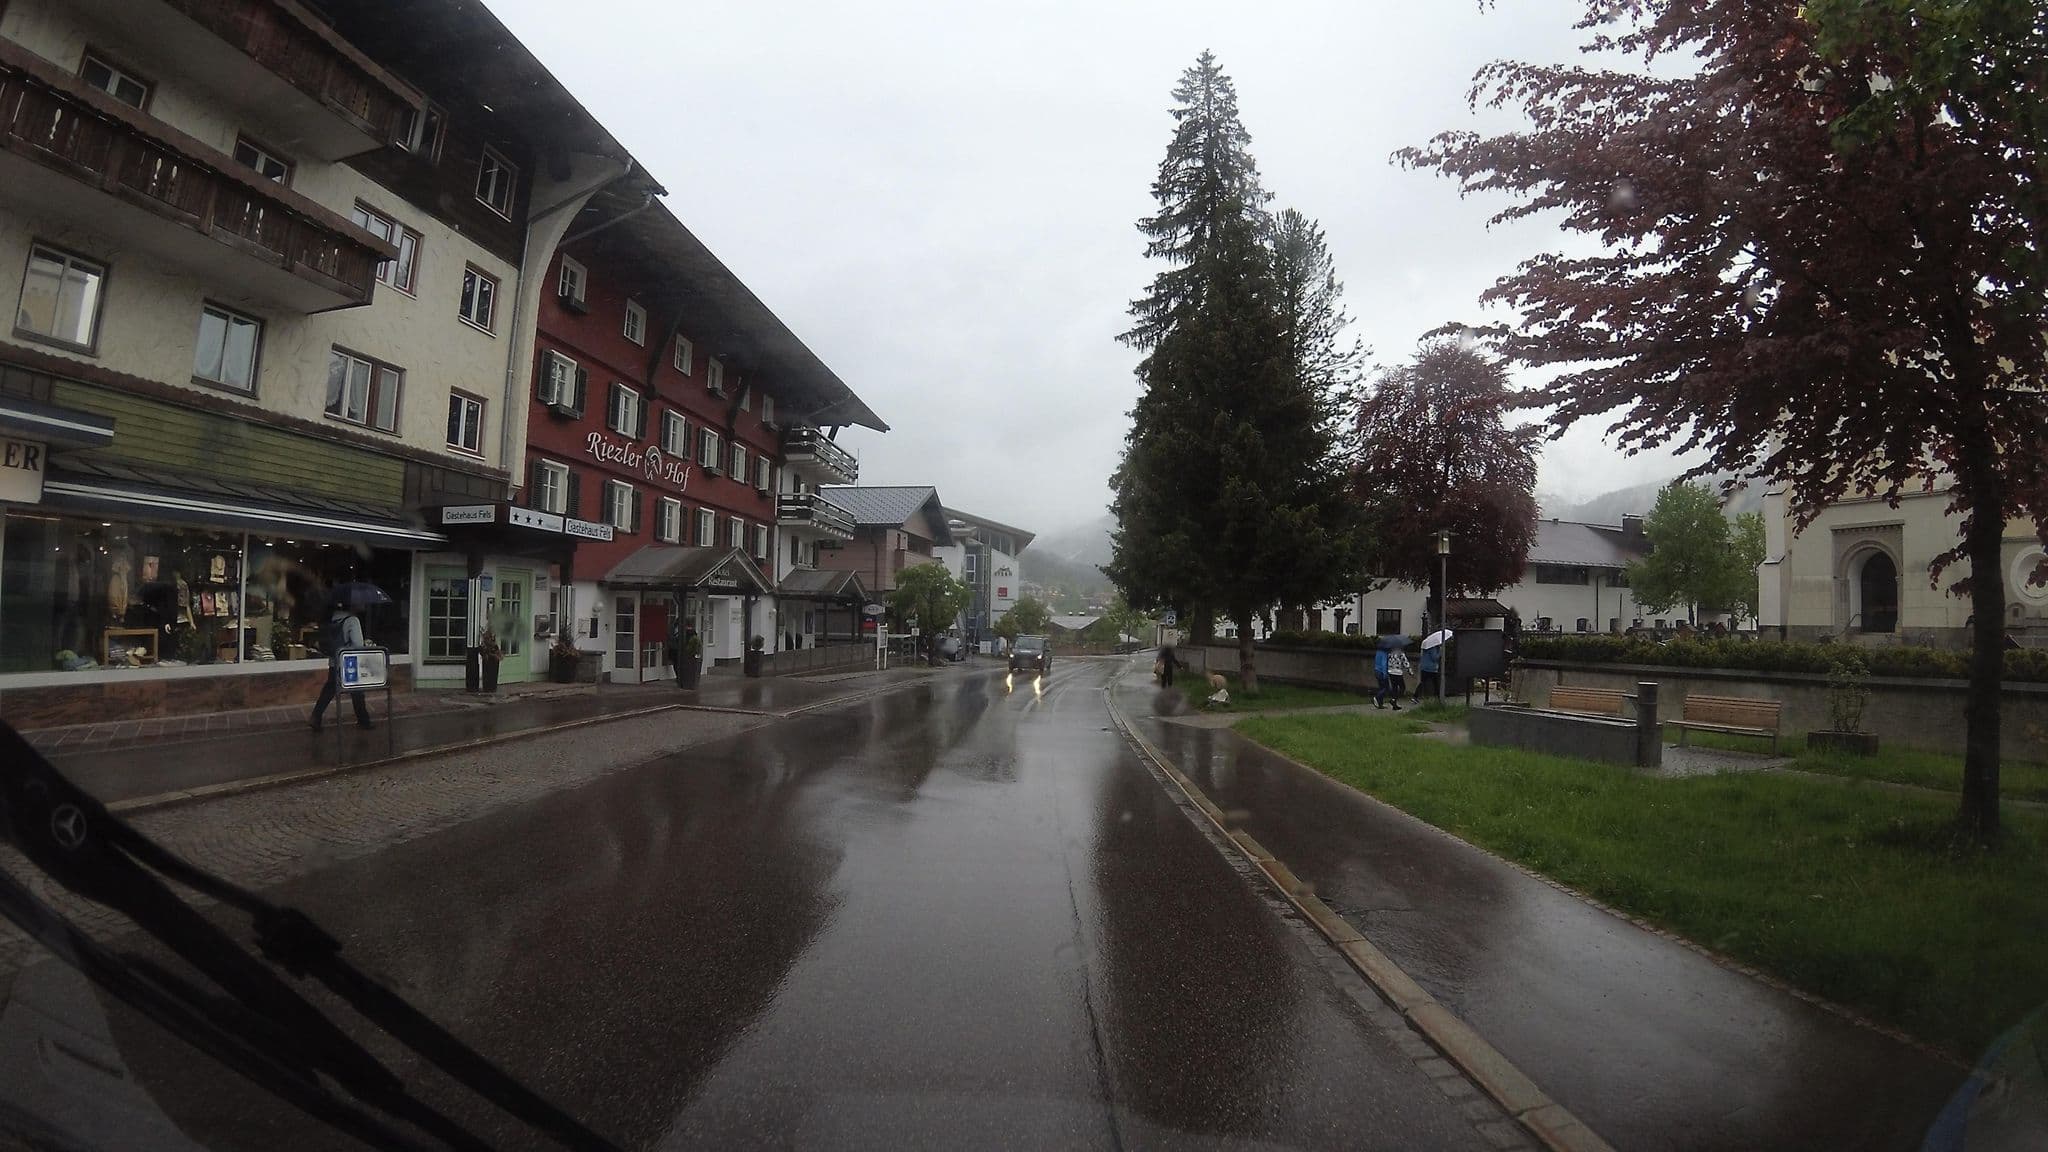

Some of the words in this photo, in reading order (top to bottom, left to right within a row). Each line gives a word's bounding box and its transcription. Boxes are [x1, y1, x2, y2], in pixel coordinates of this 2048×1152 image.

[2, 442, 40, 472] ER
[586, 432, 642, 468] Riezler
[664, 462, 691, 492] Hof
